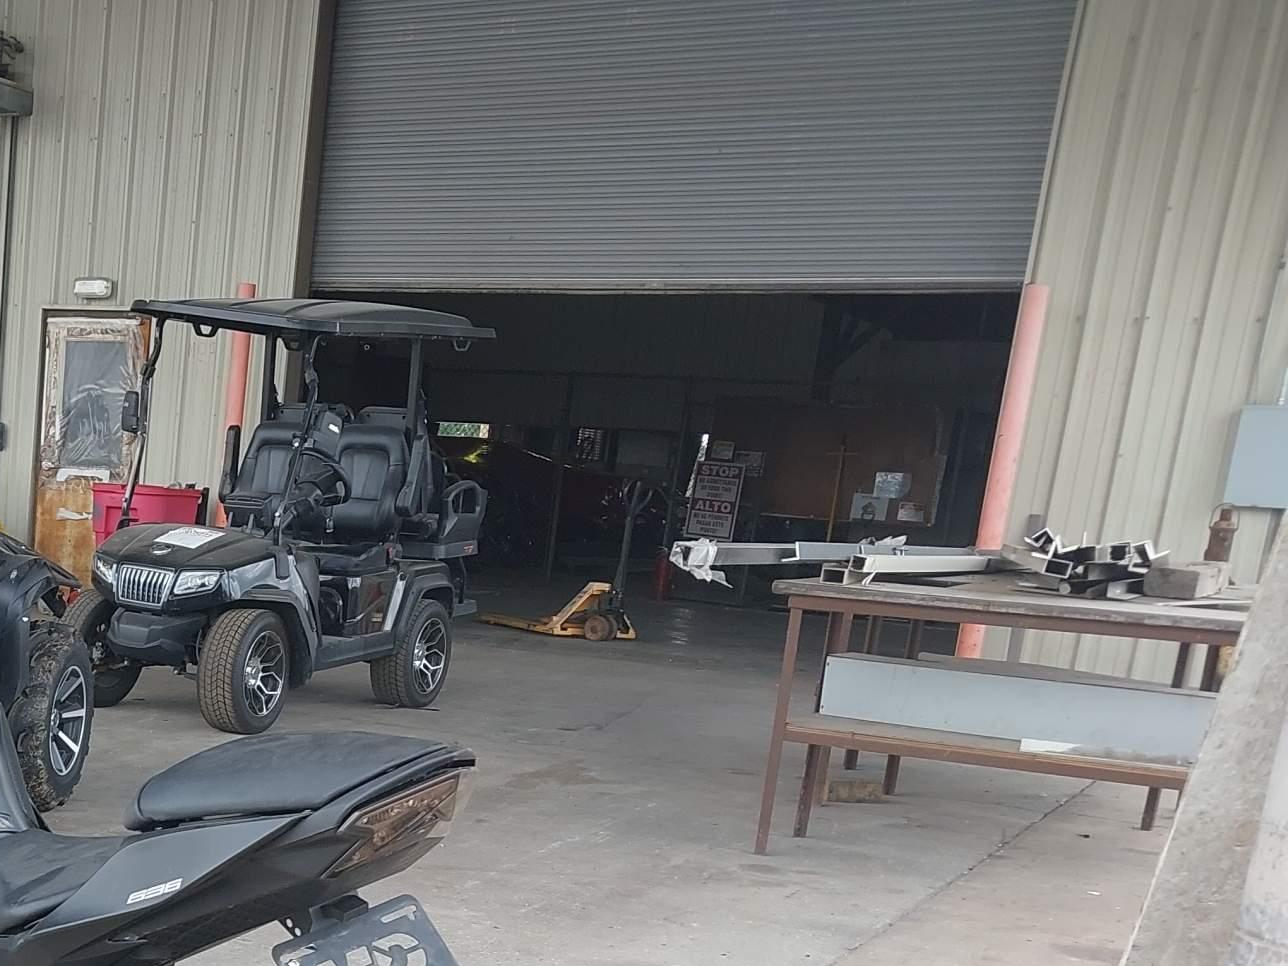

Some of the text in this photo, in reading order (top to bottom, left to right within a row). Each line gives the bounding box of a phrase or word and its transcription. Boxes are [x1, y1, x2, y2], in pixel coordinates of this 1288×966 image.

[701, 466, 738, 477] STOP
[695, 500, 730, 512] ALTO
[126, 878, 183, 905] 636
